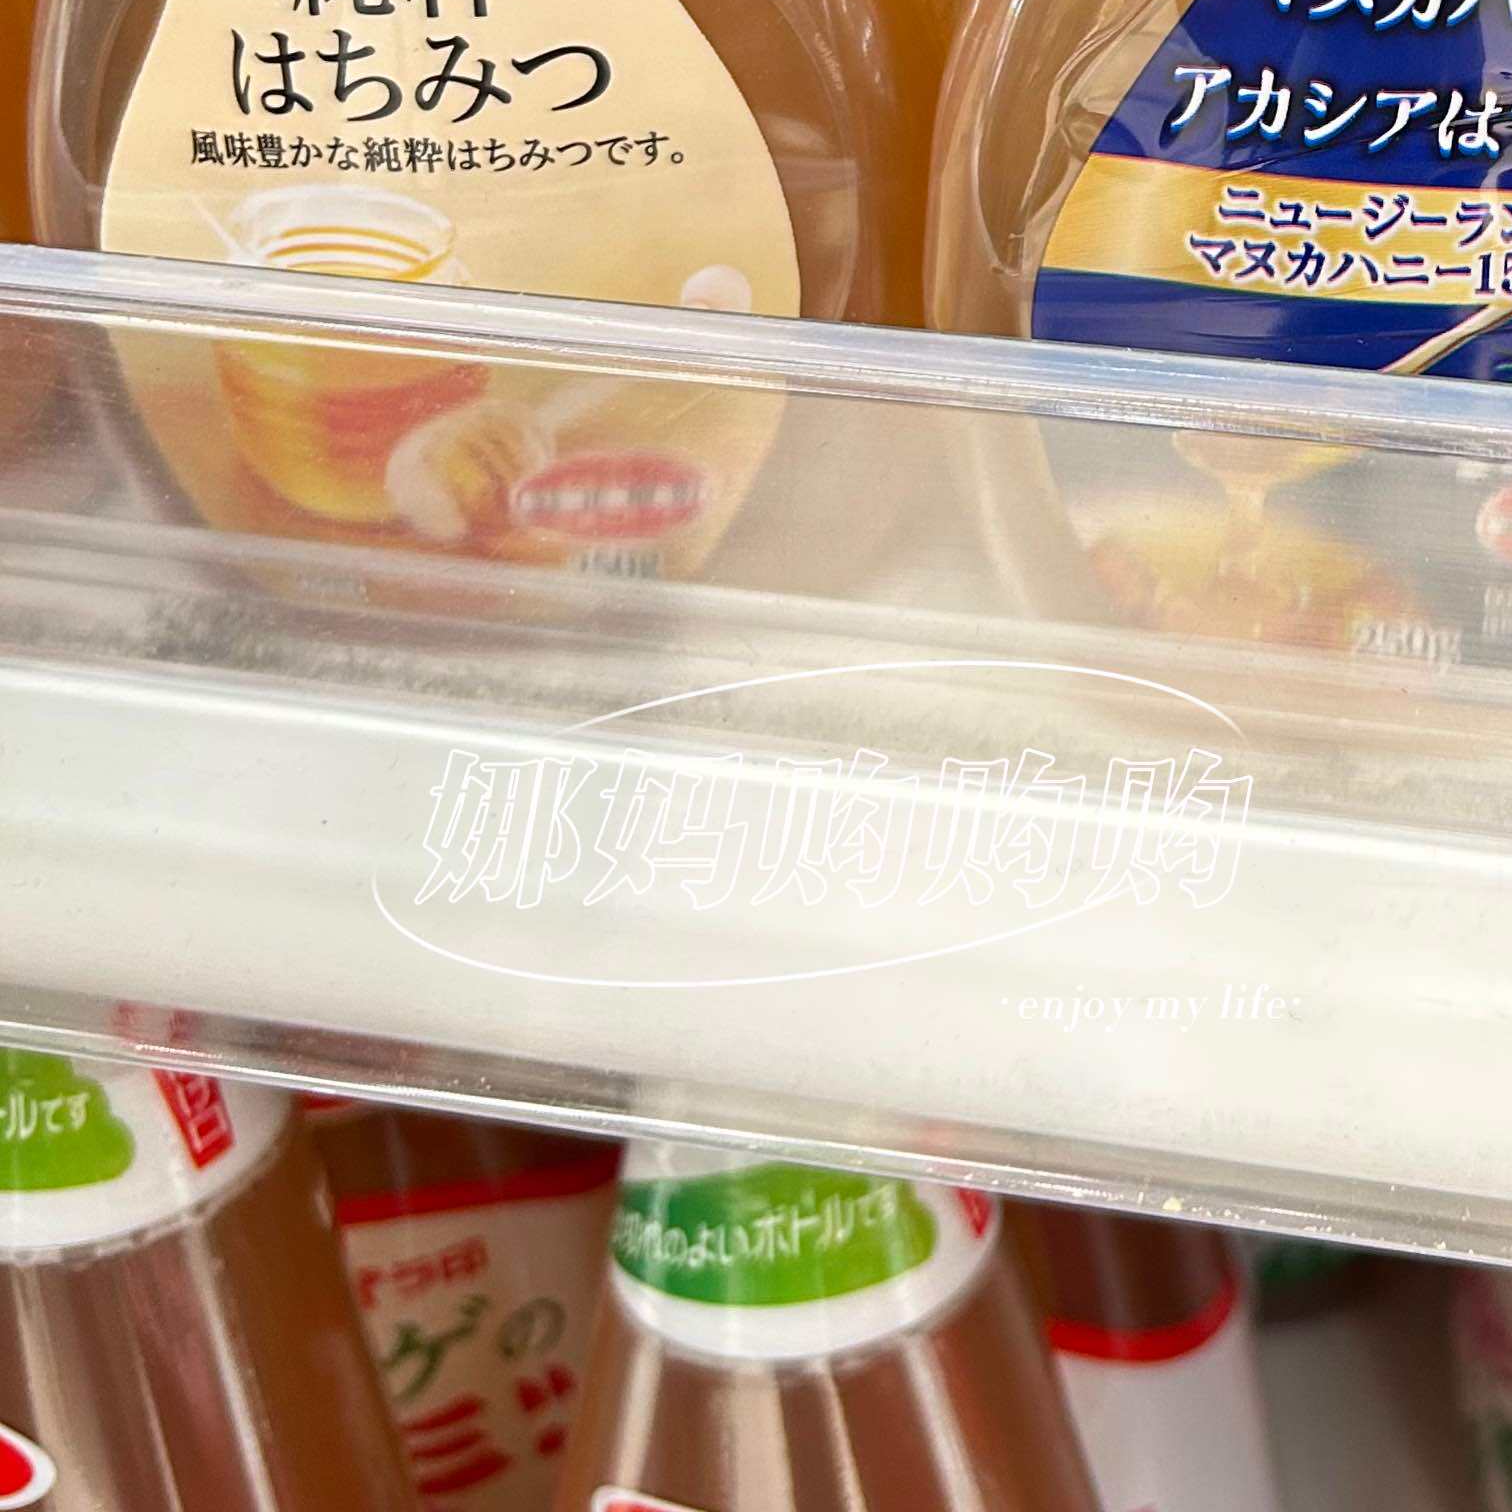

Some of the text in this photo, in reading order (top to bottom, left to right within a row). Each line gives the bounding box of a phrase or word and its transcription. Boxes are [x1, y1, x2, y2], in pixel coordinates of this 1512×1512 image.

[231, 28, 613, 123] はちみつ
[190, 128, 686, 174] 風味豊かな純粋はちみつです。
[0, 1082, 91, 1140] ルです
